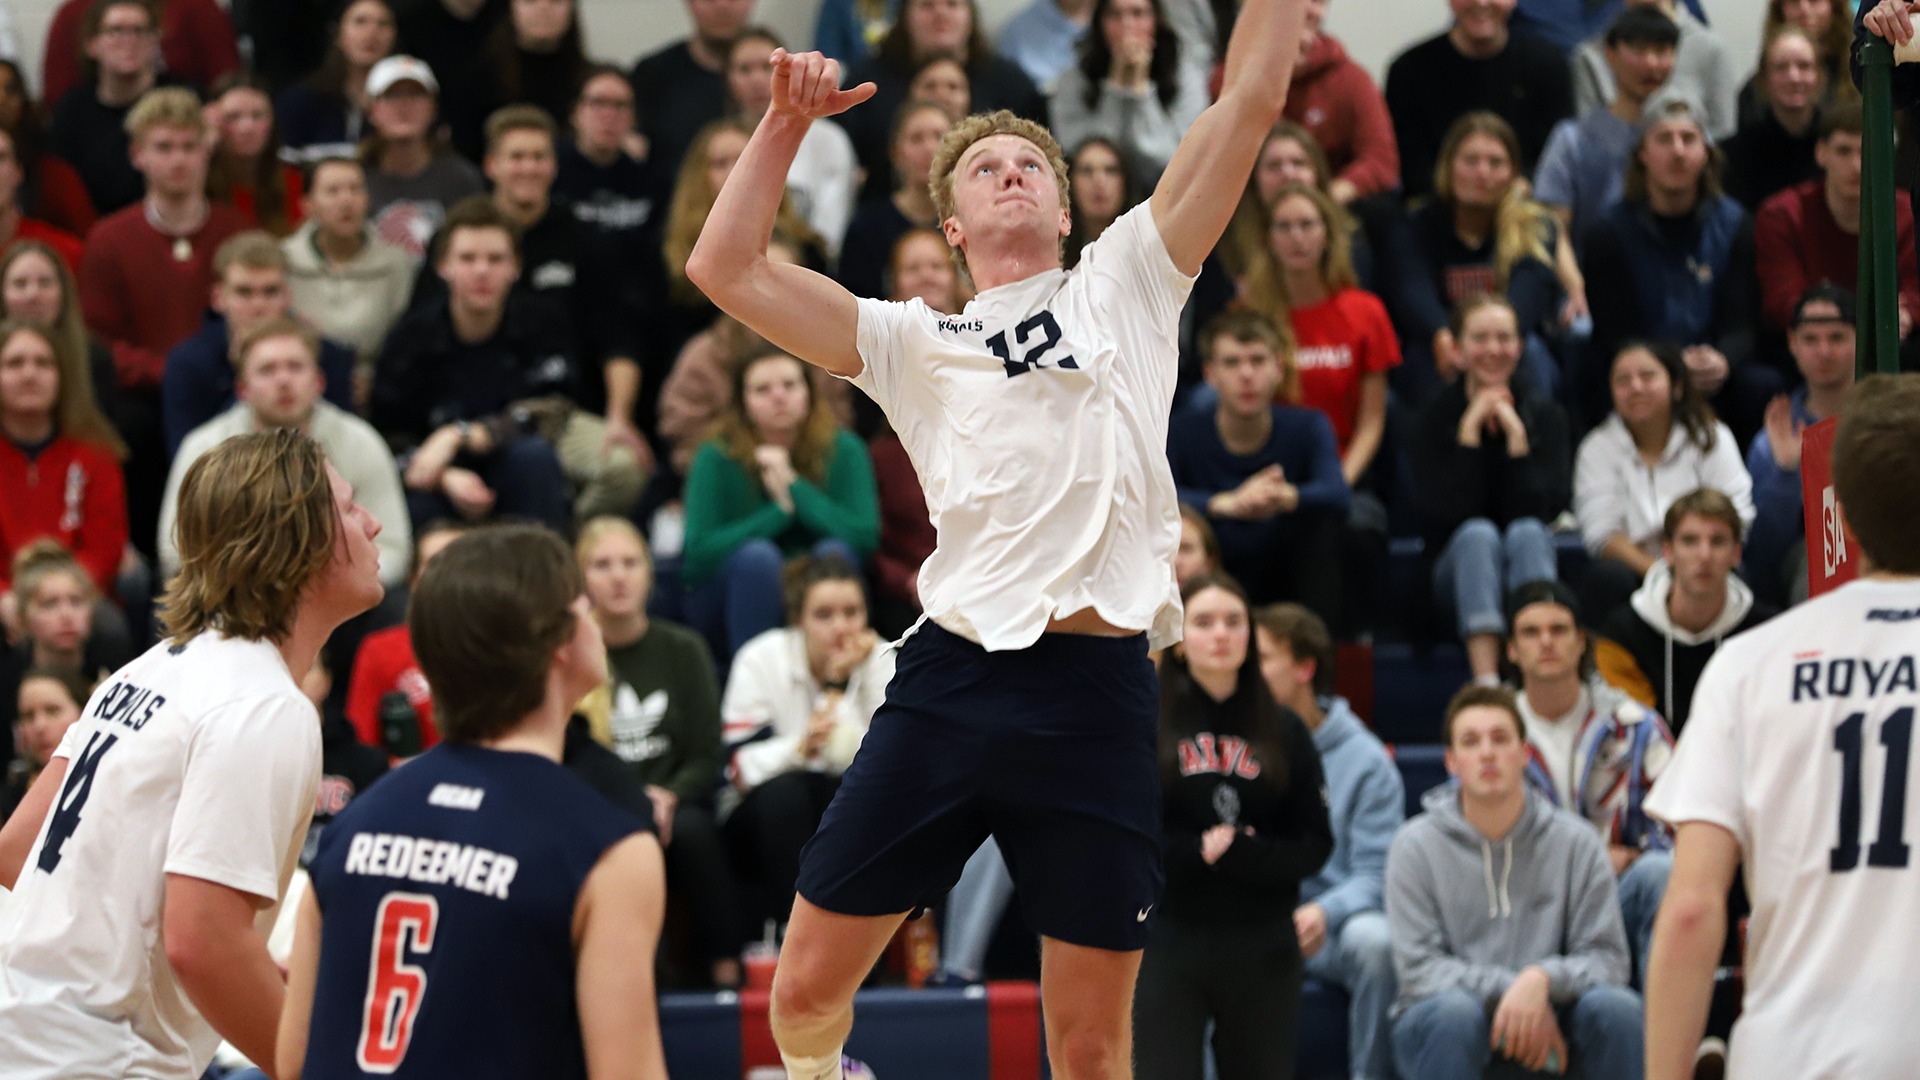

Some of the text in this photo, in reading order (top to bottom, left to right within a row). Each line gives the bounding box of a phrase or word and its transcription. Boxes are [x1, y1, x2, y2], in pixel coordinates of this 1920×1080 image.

[985, 309, 1080, 378] 12
[1829, 706, 1915, 873] 11
[344, 832, 519, 900] REDEEMER
[356, 891, 439, 1074] 6
